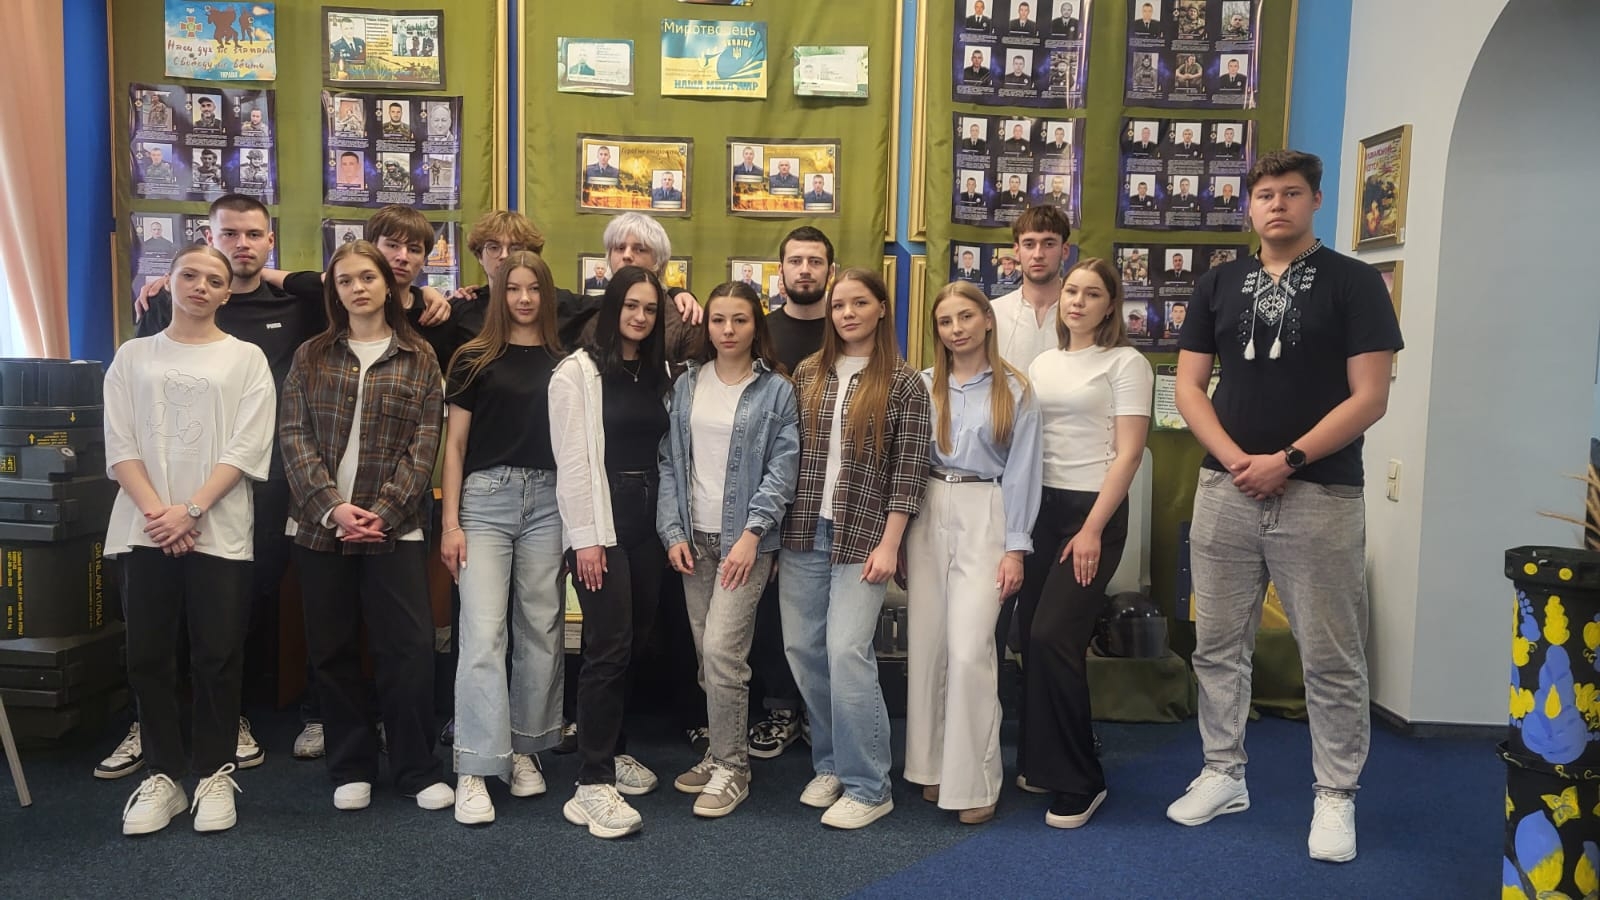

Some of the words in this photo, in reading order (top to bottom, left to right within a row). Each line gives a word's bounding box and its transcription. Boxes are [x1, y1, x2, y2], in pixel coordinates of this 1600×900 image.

[664, 21, 756, 38] Миротвоець
[167, 39, 193, 52] Наш
[197, 46, 213, 57] дух
[674, 79, 704, 89] НАША
